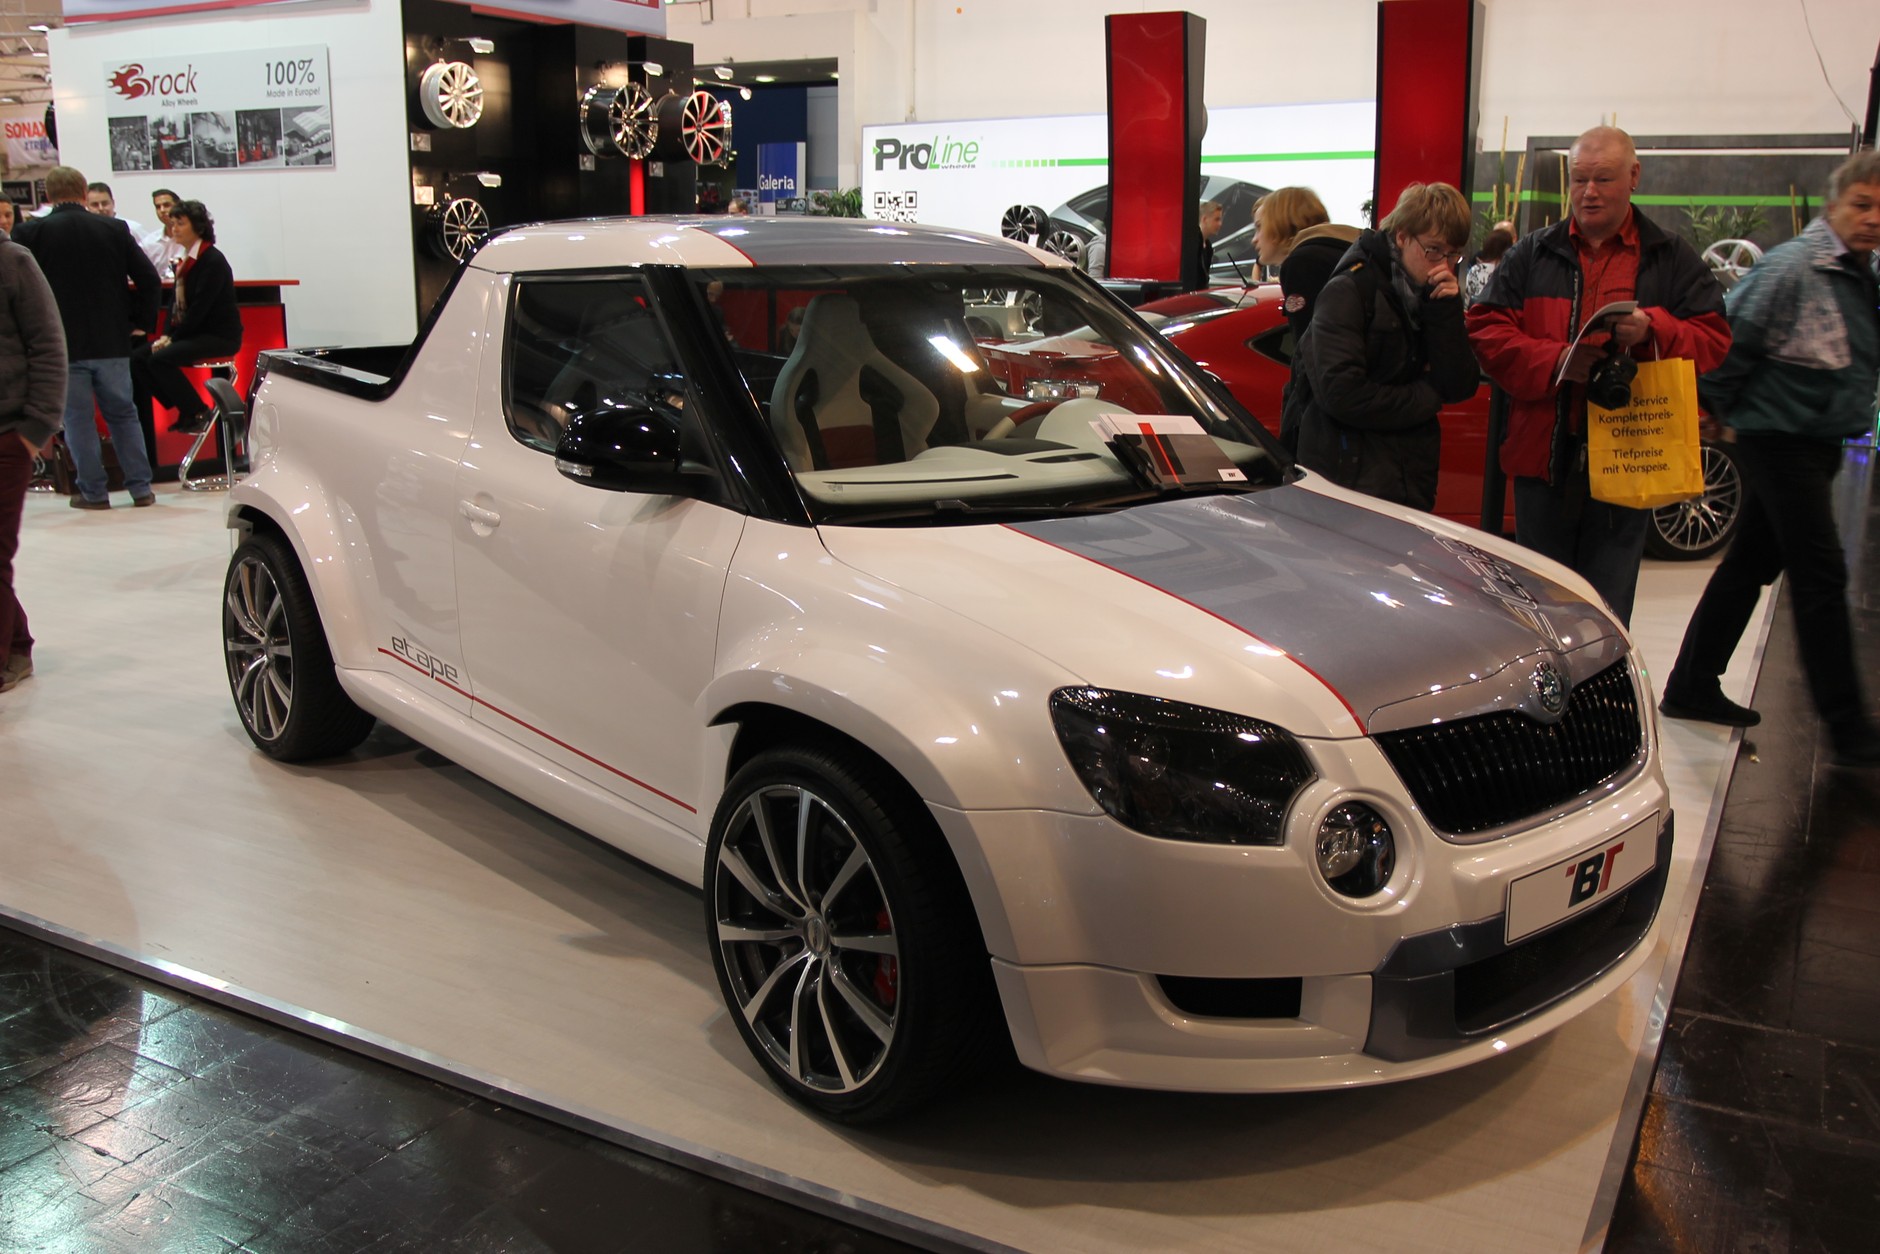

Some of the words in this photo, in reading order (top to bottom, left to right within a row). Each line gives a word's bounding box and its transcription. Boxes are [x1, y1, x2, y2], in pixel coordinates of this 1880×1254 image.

[266, 58, 315, 85] 100%
[107, 63, 197, 100] Brock
[162, 100, 176, 108] Alloy
[178, 98, 198, 106] Wheels
[873, 136, 979, 171] ProLine
[759, 174, 795, 191] Galeria
[1633, 395, 1668, 408] Service
[1598, 408, 1674, 425] Komplettpreis-
[1611, 425, 1664, 438] Offensive:
[1611, 447, 1664, 460] Tiefpreise
[1602, 463, 1619, 475] mit
[1622, 462, 1671, 476] Vorspeise.
[391, 636, 460, 685] etape
